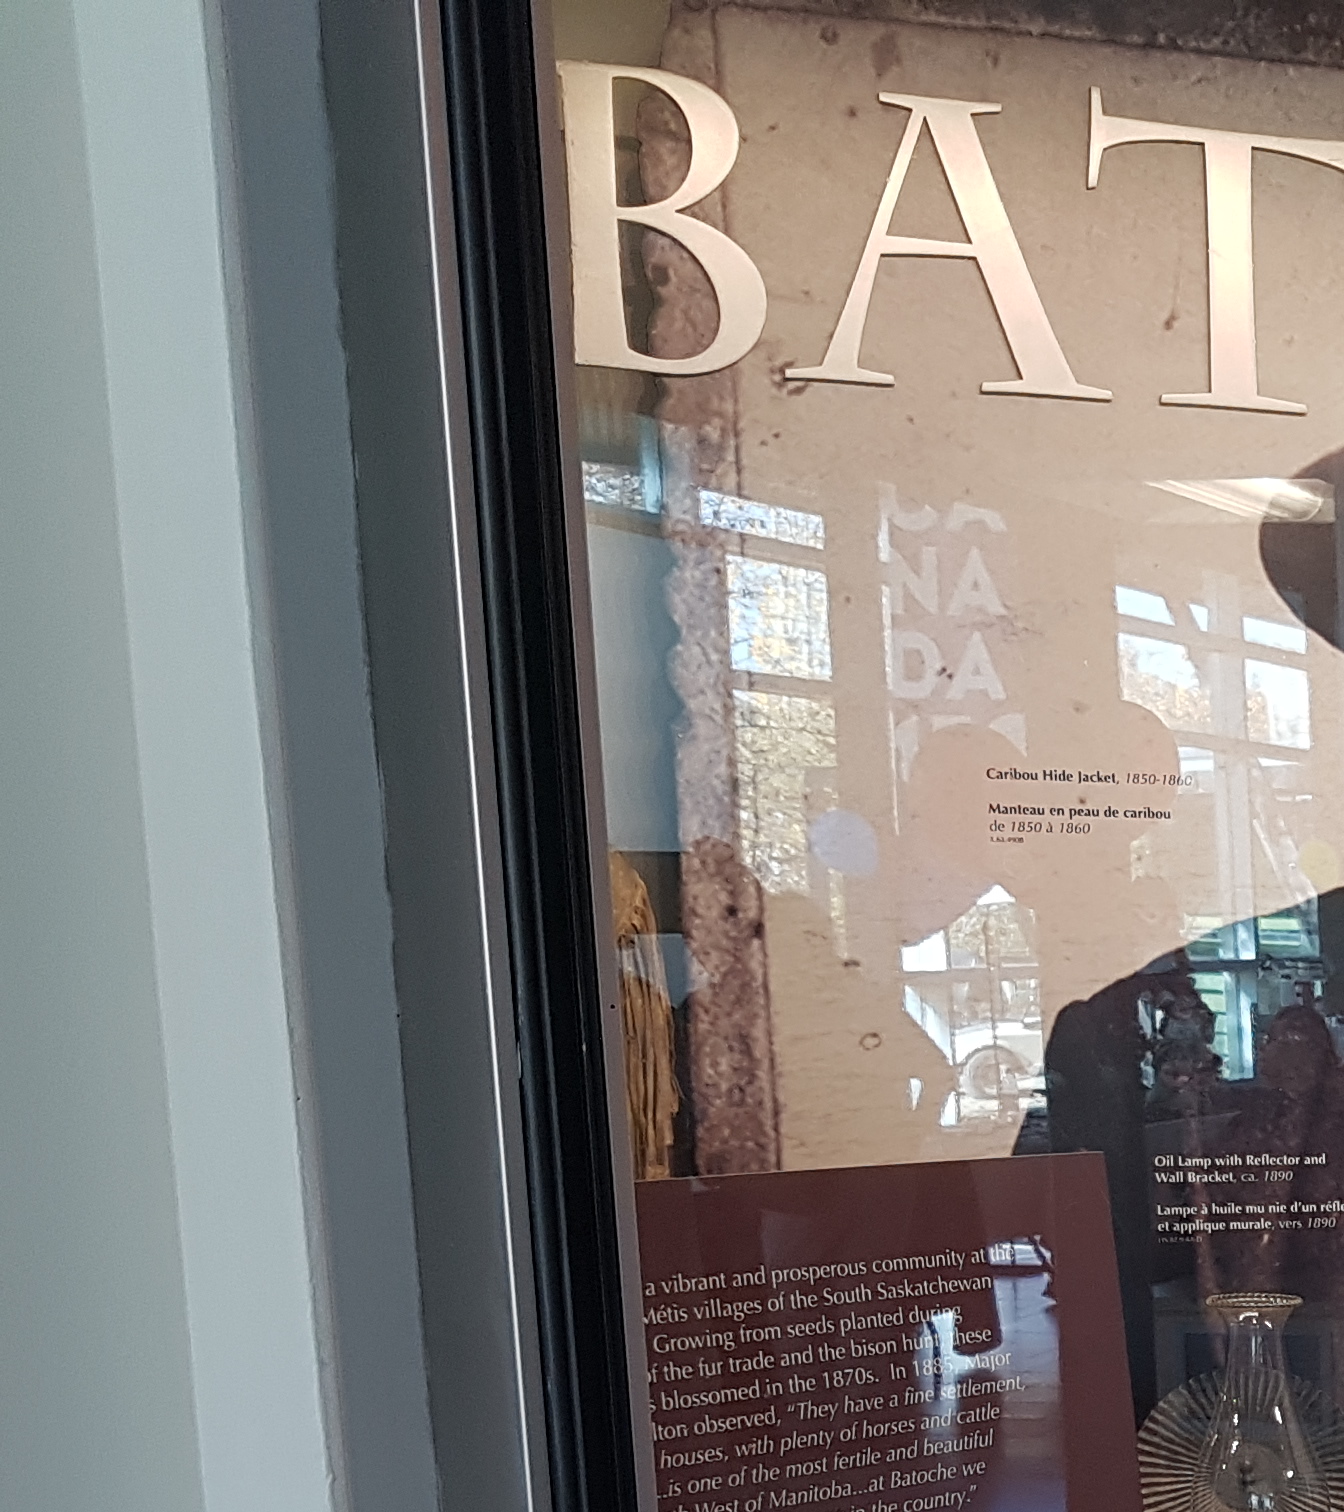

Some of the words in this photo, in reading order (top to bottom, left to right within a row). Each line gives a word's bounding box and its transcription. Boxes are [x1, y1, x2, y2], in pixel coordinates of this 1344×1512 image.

[986, 767, 1038, 781] Caribou
[1042, 769, 1073, 782] Hide
[1077, 770, 1119, 785] Jacket,
[1126, 772, 1192, 786] 1850-1860
[988, 803, 1045, 816] Manteau
[1049, 807, 1064, 816] en
[1068, 807, 1099, 820] peau
[1103, 805, 1119, 818] de
[1123, 806, 1171, 819] caribou
[989, 819, 1005, 832] de
[1011, 821, 1042, 833] 1850
[1045, 821, 1053, 833] à
[1060, 822, 1090, 834] 1860
[1154, 1154, 1174, 1167] Oil
[1178, 1155, 1211, 1170] Lamp
[1214, 1153, 1242, 1166] with
[1246, 1153, 1300, 1166] Reflector
[1303, 1152, 1326, 1165] and
[1154, 1171, 1183, 1183] Wall
[1240, 1173, 1258, 1182] ca.
[1264, 1170, 1293, 1181] 1890
[1157, 1204, 1197, 1218] Lampe
[1200, 1203, 1207, 1214] à
[1211, 1202, 1242, 1214] huile
[1289, 1200, 1317, 1213] d’un
[1157, 1221, 1169, 1232] et
[1172, 1219, 1226, 1234] applique
[1229, 1217, 1274, 1230] murale,
[1278, 1220, 1302, 1228] vers
[1308, 1217, 1336, 1228] 1890
[660, 1272, 726, 1293] vibrant
[732, 1264, 766, 1287] and
[771, 1261, 867, 1289] prosperous
[872, 1248, 965, 1273] community
[971, 1248, 986, 1264] at
[990, 1243, 1015, 1261] the
[693, 1298, 762, 1321] villages
[767, 1291, 784, 1311] of
[790, 1289, 818, 1309] the
[823, 1282, 871, 1306] South
[877, 1275, 991, 1300] Saskatchewan
[653, 1329, 735, 1353] Growing
[739, 1323, 781, 1343] from
[786, 1314, 835, 1338] seeds
[839, 1306, 903, 1337] planted
[663, 1361, 693, 1381] the
[698, 1357, 723, 1376] fur
[728, 1350, 774, 1373] trade
[780, 1344, 813, 1366] and
[817, 1342, 845, 1362] the
[850, 1338, 897, 1357] bison
[660, 1378, 760, 1410] blossomed
[765, 1378, 783, 1396] in
[788, 1373, 816, 1393] the
[822, 1367, 879, 1389] 1870s.
[890, 1362, 906, 1380] In
[693, 1404, 781, 1435] observed,
[844, 1394, 884, 1414] have
[889, 1394, 898, 1407] a
[904, 1386, 934, 1405] fine
[941, 1375, 1025, 1398] settlement,
[660, 1447, 728, 1469] houses,
[734, 1434, 773, 1457] with
[780, 1430, 834, 1457] plenty
[839, 1421, 858, 1442] of
[862, 1418, 915, 1439] horses
[920, 1409, 951, 1430] and
[956, 1402, 1000, 1424] cattle
